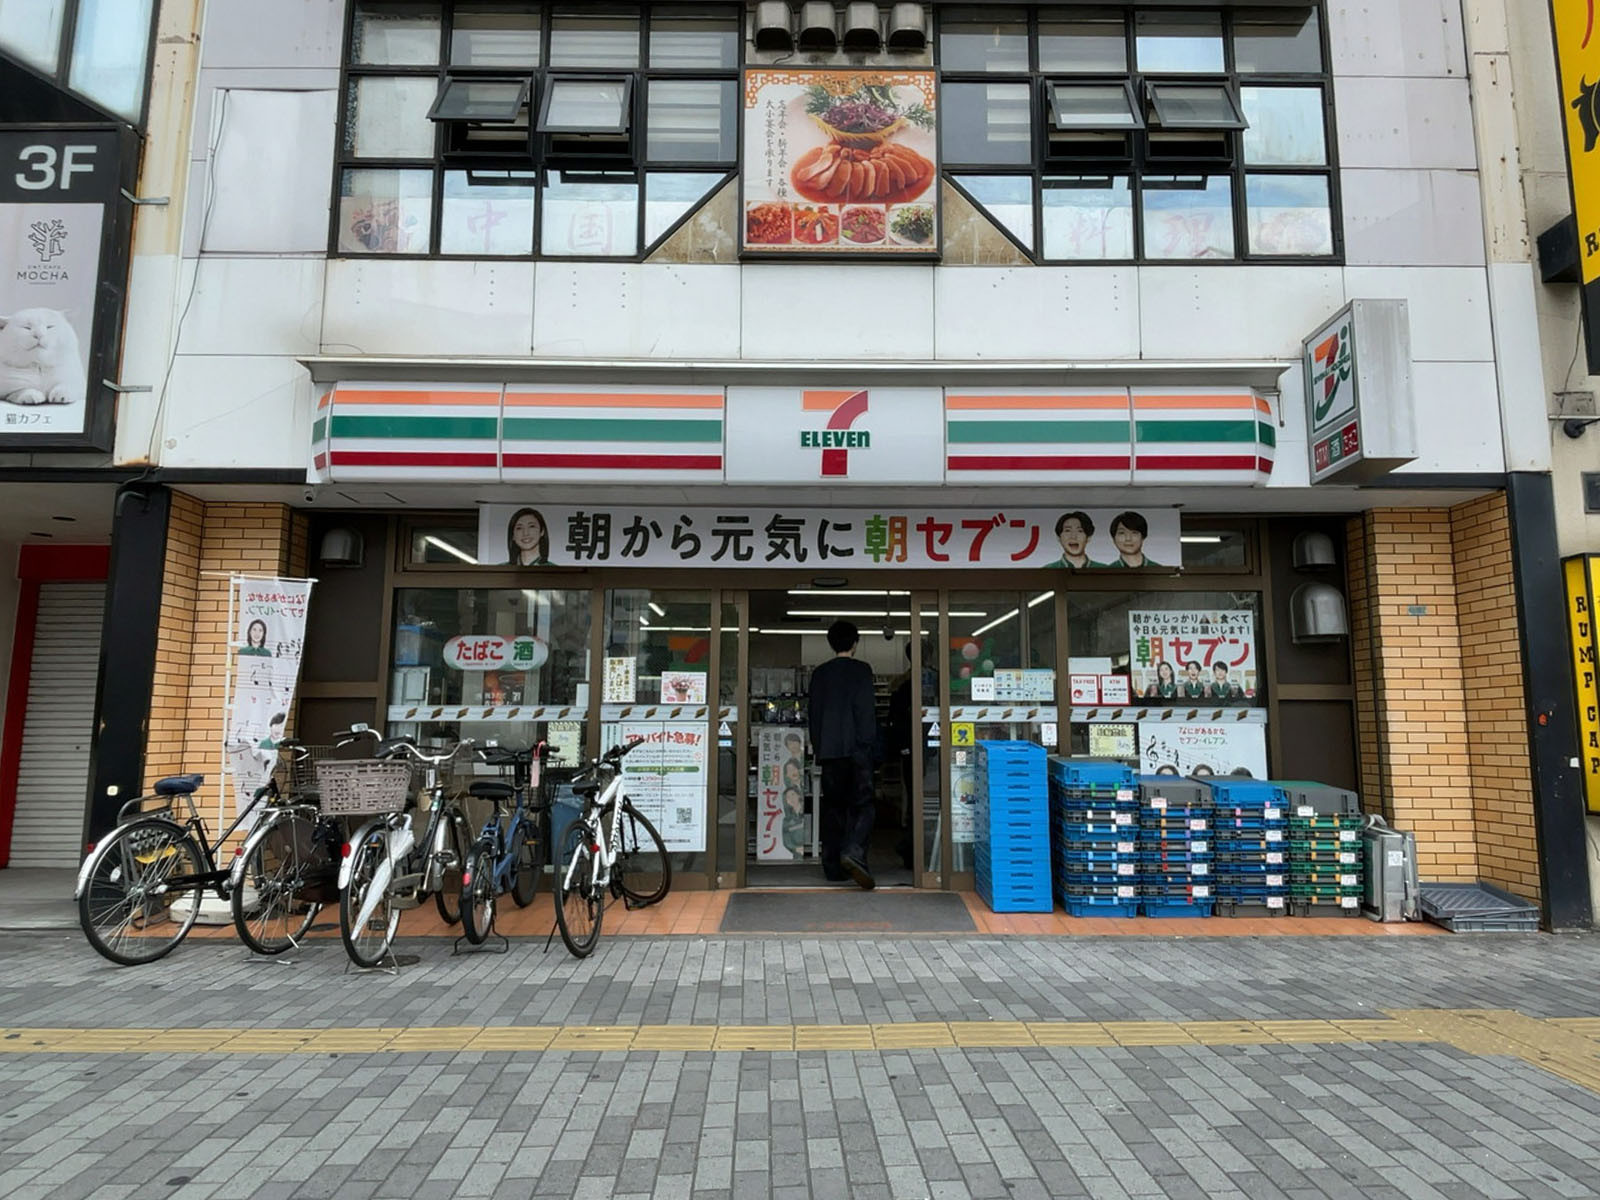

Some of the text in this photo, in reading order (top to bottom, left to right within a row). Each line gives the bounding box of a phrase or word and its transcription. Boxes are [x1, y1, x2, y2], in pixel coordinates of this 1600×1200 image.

[15, 145, 97, 190] 3F
[17, 271, 69, 281] MOCHA
[6, 413, 52, 425] 猫カフェ
[803, 390, 868, 475] 7
[566, 510, 1040, 563] 朝から元気に朝セブン
[456, 641, 534, 661] たばこ 酒
[1136, 635, 1250, 668] 朝セブン
[1576, 596, 1600, 774] RUMP CAP
[762, 764, 782, 854] 朝セブン
